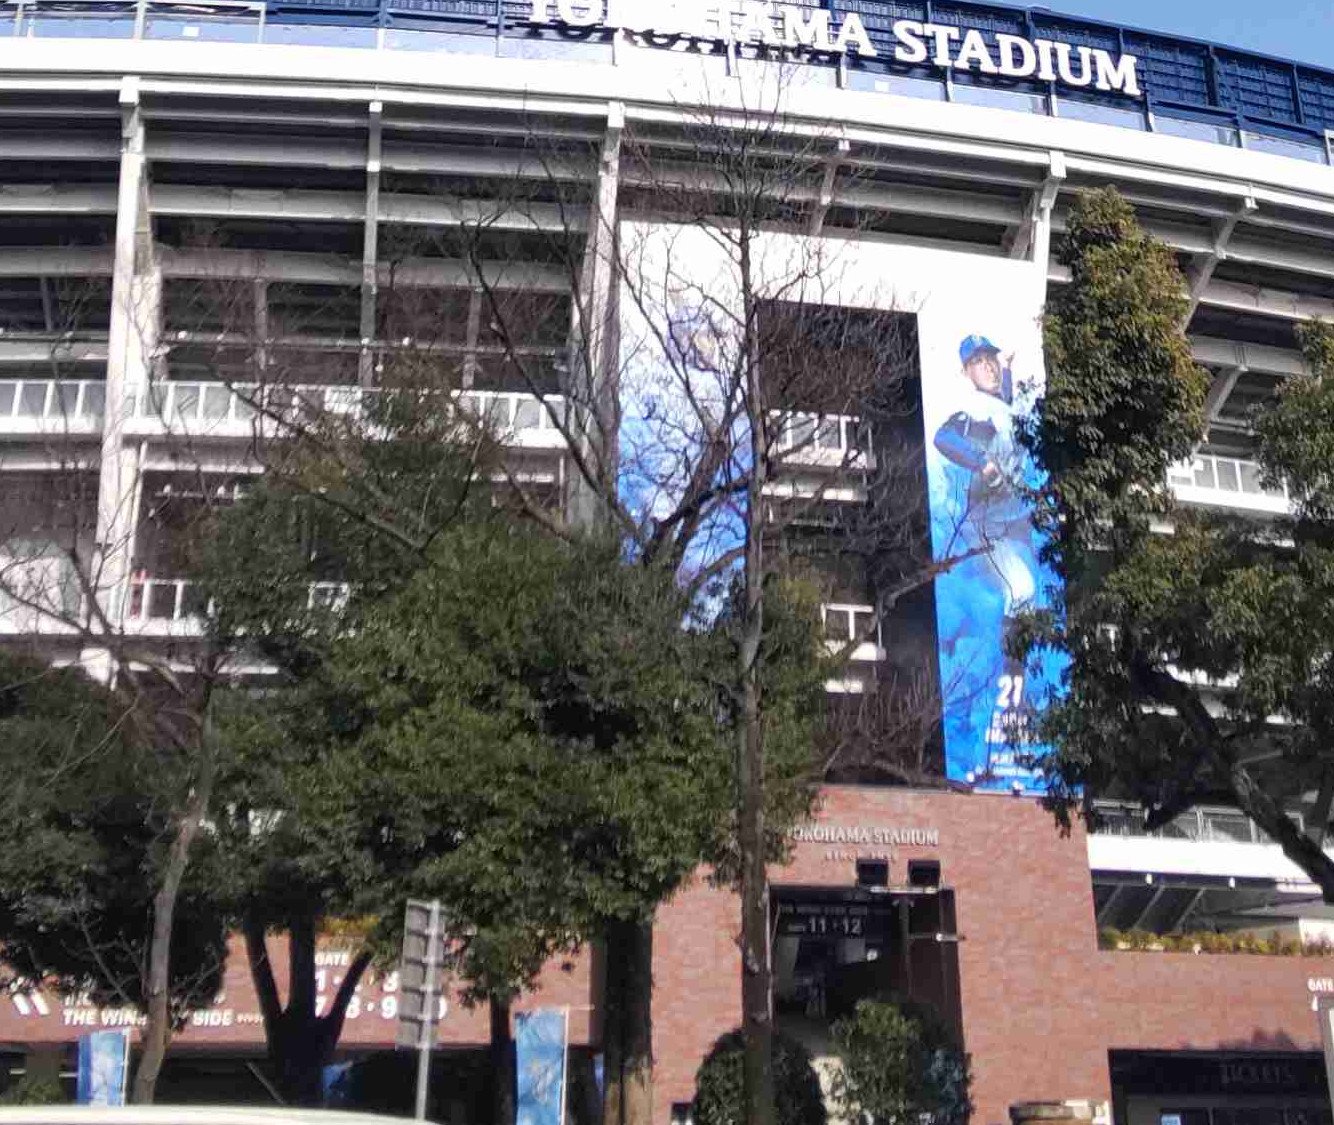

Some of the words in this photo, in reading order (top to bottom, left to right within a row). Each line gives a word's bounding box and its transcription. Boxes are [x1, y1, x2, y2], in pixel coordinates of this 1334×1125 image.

[892, 20, 1142, 97] STADIUM
[874, 827, 939, 846] STADIUM
[1308, 979, 1334, 992] GATE
[63, 1009, 98, 1025] THE
[192, 1009, 234, 1025] SIDE
